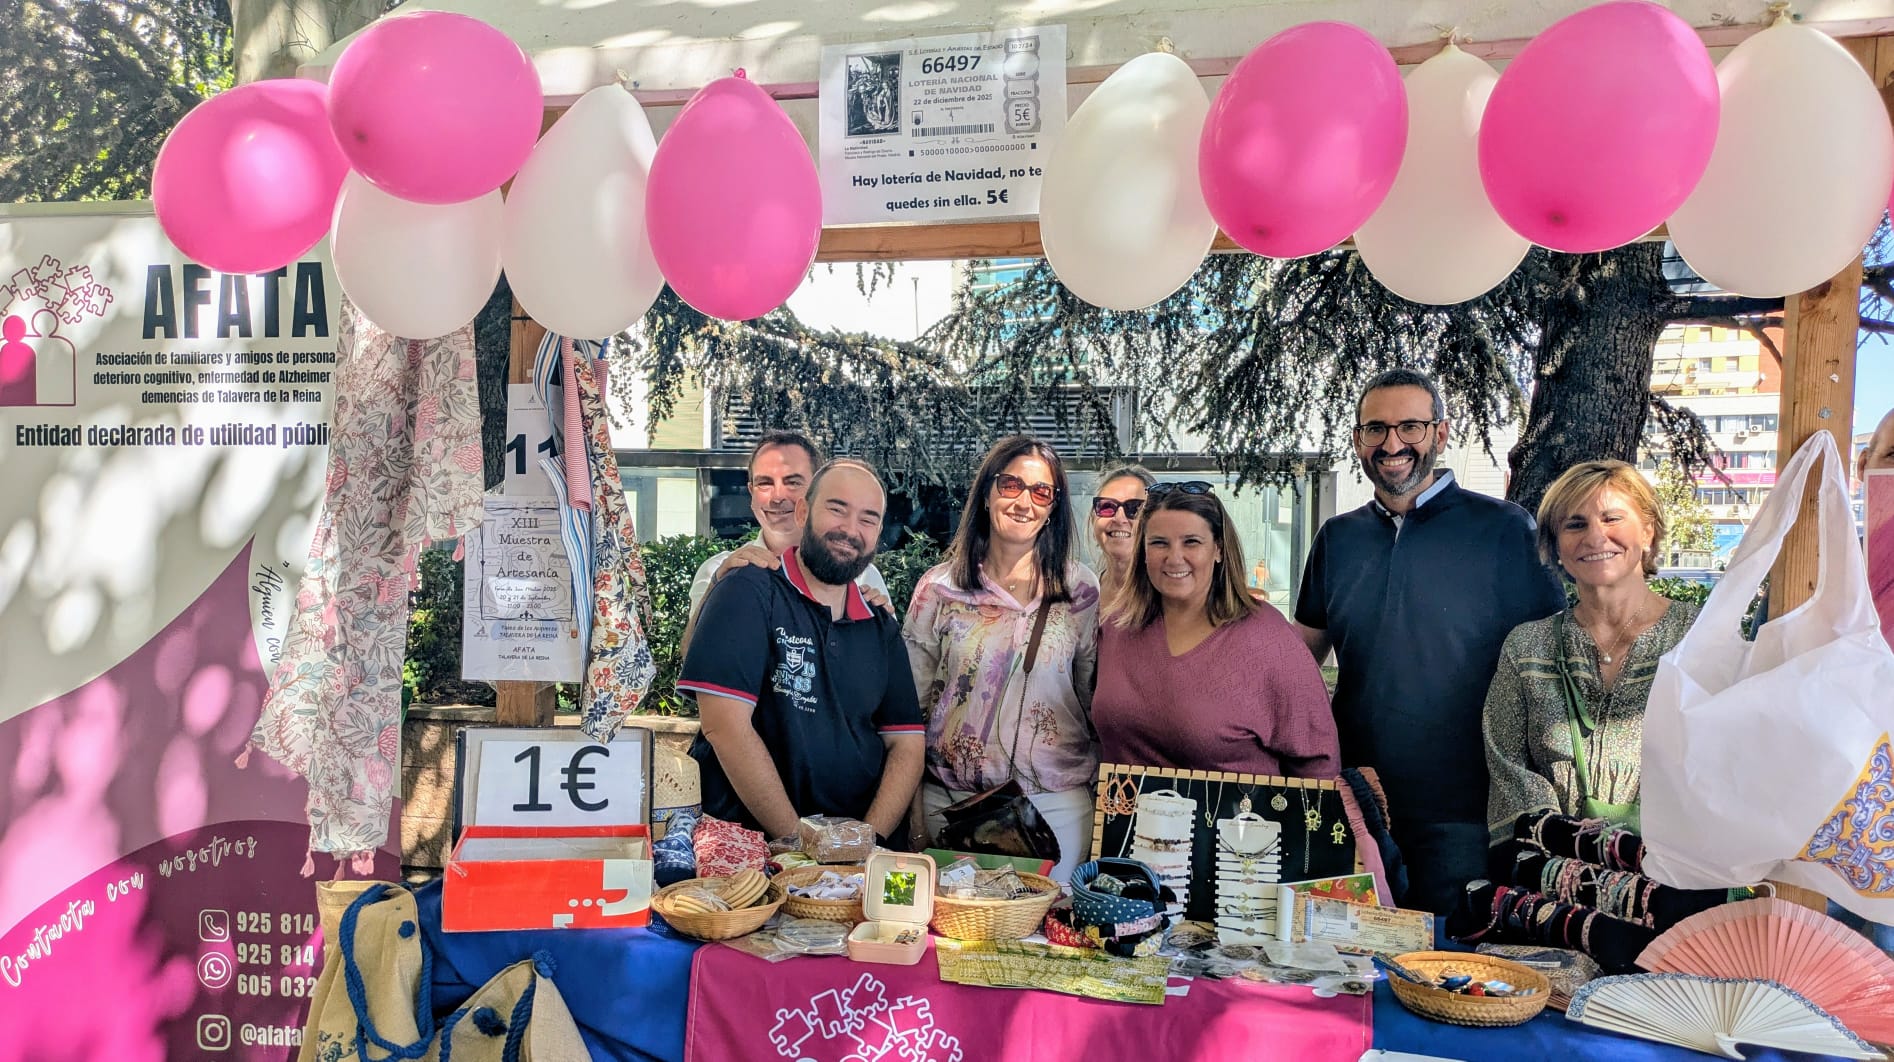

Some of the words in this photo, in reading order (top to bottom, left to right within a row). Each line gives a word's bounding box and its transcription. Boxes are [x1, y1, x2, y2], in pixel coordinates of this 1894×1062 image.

[922, 55, 982, 75] 66497
[908, 77, 948, 88] LOTERÍA
[950, 73, 999, 84] NACIONAL
[923, 97, 932, 105] de
[932, 94, 965, 104] diciembre
[967, 94, 976, 102] de
[977, 93, 993, 101] 2025
[924, 88, 937, 96] DE
[939, 85, 982, 95] NAVIDAD
[1014, 108, 1031, 122] 5€
[852, 174, 878, 187] Hay
[881, 171, 922, 185] lotería
[927, 168, 942, 182] de
[944, 164, 1006, 181] Navidad,
[1009, 167, 1025, 178] no
[1028, 165, 1042, 177] te
[886, 198, 930, 211] quedes
[933, 196, 950, 207] sin
[953, 194, 982, 206] ella.
[986, 188, 1009, 205] 5€
[142, 261, 330, 339] AFATA
[95, 350, 153, 366] Asociación
[154, 351, 168, 365] de
[170, 350, 223, 365] familiares
[225, 354, 232, 367] y
[234, 351, 274, 367] amigos
[275, 350, 290, 364] de
[292, 351, 336, 367] persona
[93, 371, 141, 385] deterioro
[143, 370, 195, 388] cognitivo,
[198, 370, 260, 385] enfermedad
[262, 370, 276, 385] de
[279, 369, 331, 383] Alzheimer
[141, 390, 200, 404] demencias
[202, 390, 216, 403] de
[217, 389, 261, 404] Talavera
[263, 389, 277, 403] de
[279, 389, 289, 403] la
[292, 389, 322, 403] Reina
[16, 424, 81, 446] Entidad
[87, 424, 177, 446] declarada
[181, 424, 204, 446] de
[209, 423, 276, 446] utilidad
[511, 517, 540, 529] XIII
[499, 533, 551, 546] Muestra
[517, 551, 533, 561] de
[496, 566, 559, 579] Artesanía
[512, 745, 611, 812] 1€
[1, 898, 95, 988] Contacta
[106, 870, 145, 902] con
[158, 835, 258, 878] nosotros
[237, 911, 272, 934] 925
[280, 911, 315, 934] 814
[237, 942, 272, 965] 925
[280, 943, 315, 966] 814
[237, 974, 272, 997] 605
[280, 974, 318, 997] 032
